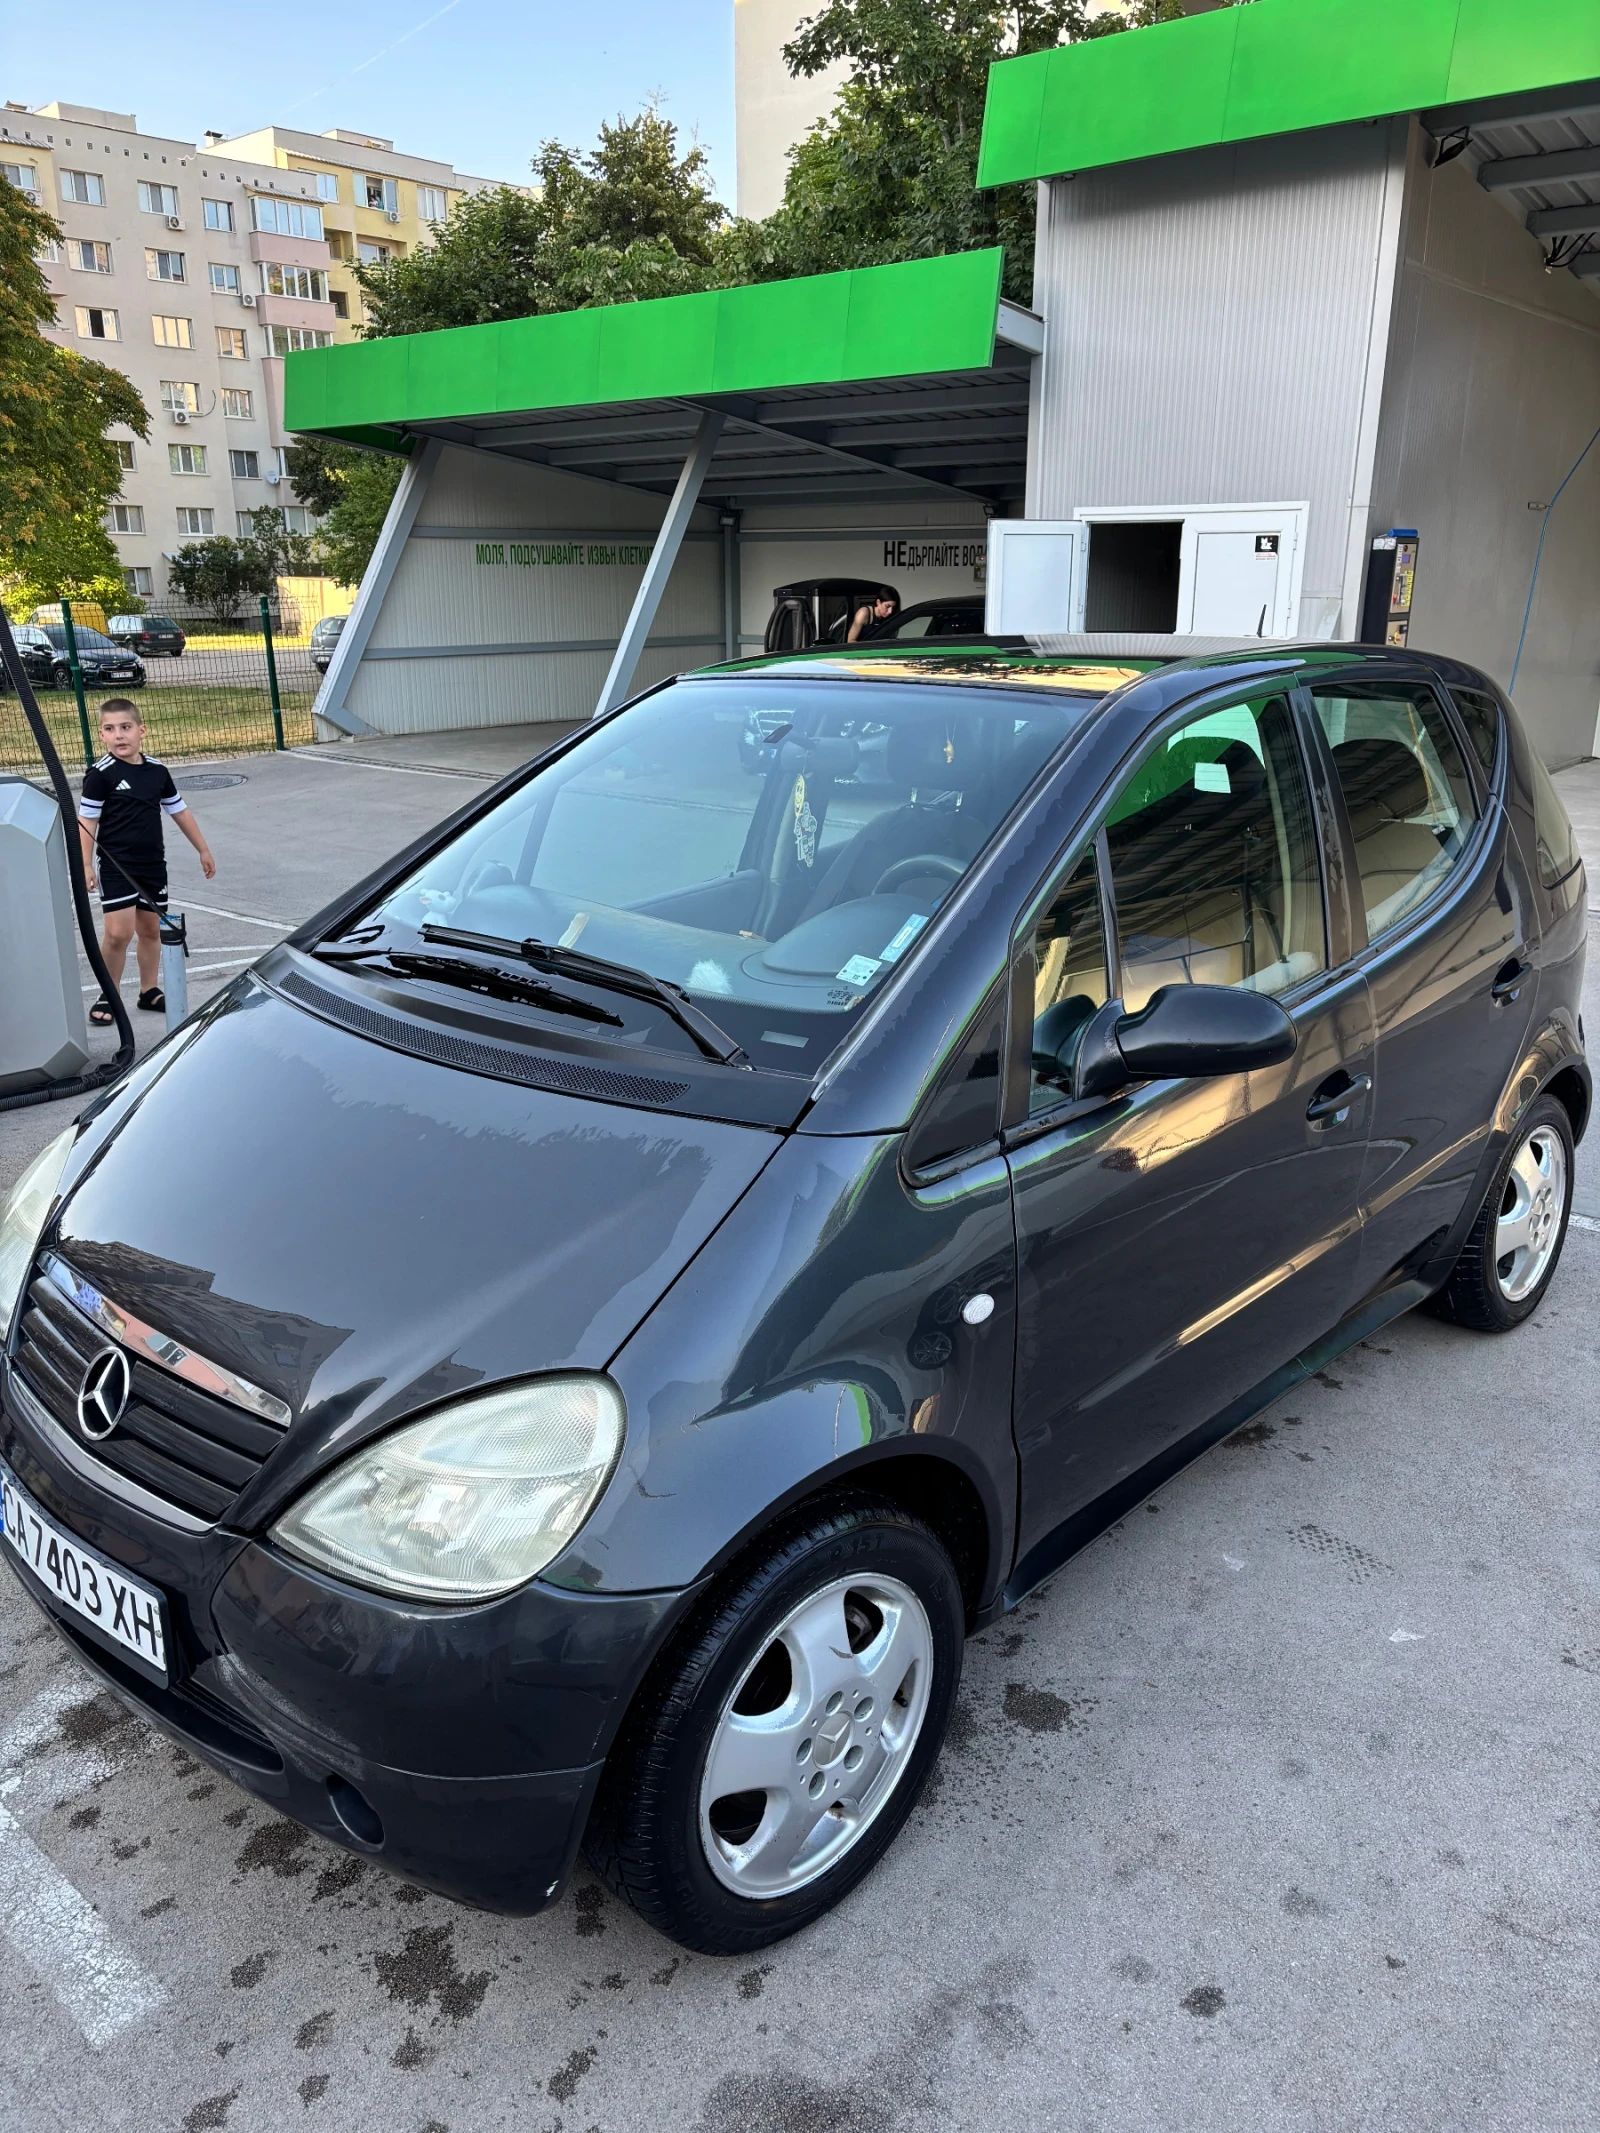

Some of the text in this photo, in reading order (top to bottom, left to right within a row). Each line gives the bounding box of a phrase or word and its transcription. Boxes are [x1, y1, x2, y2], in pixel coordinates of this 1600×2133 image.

[475, 543, 508, 569] МОЛЯ,
[509, 541, 584, 569] ПОДСУШАВАЙТЕ
[587, 545, 616, 566] ИЗВЪН
[962, 544, 987, 567] ВО
